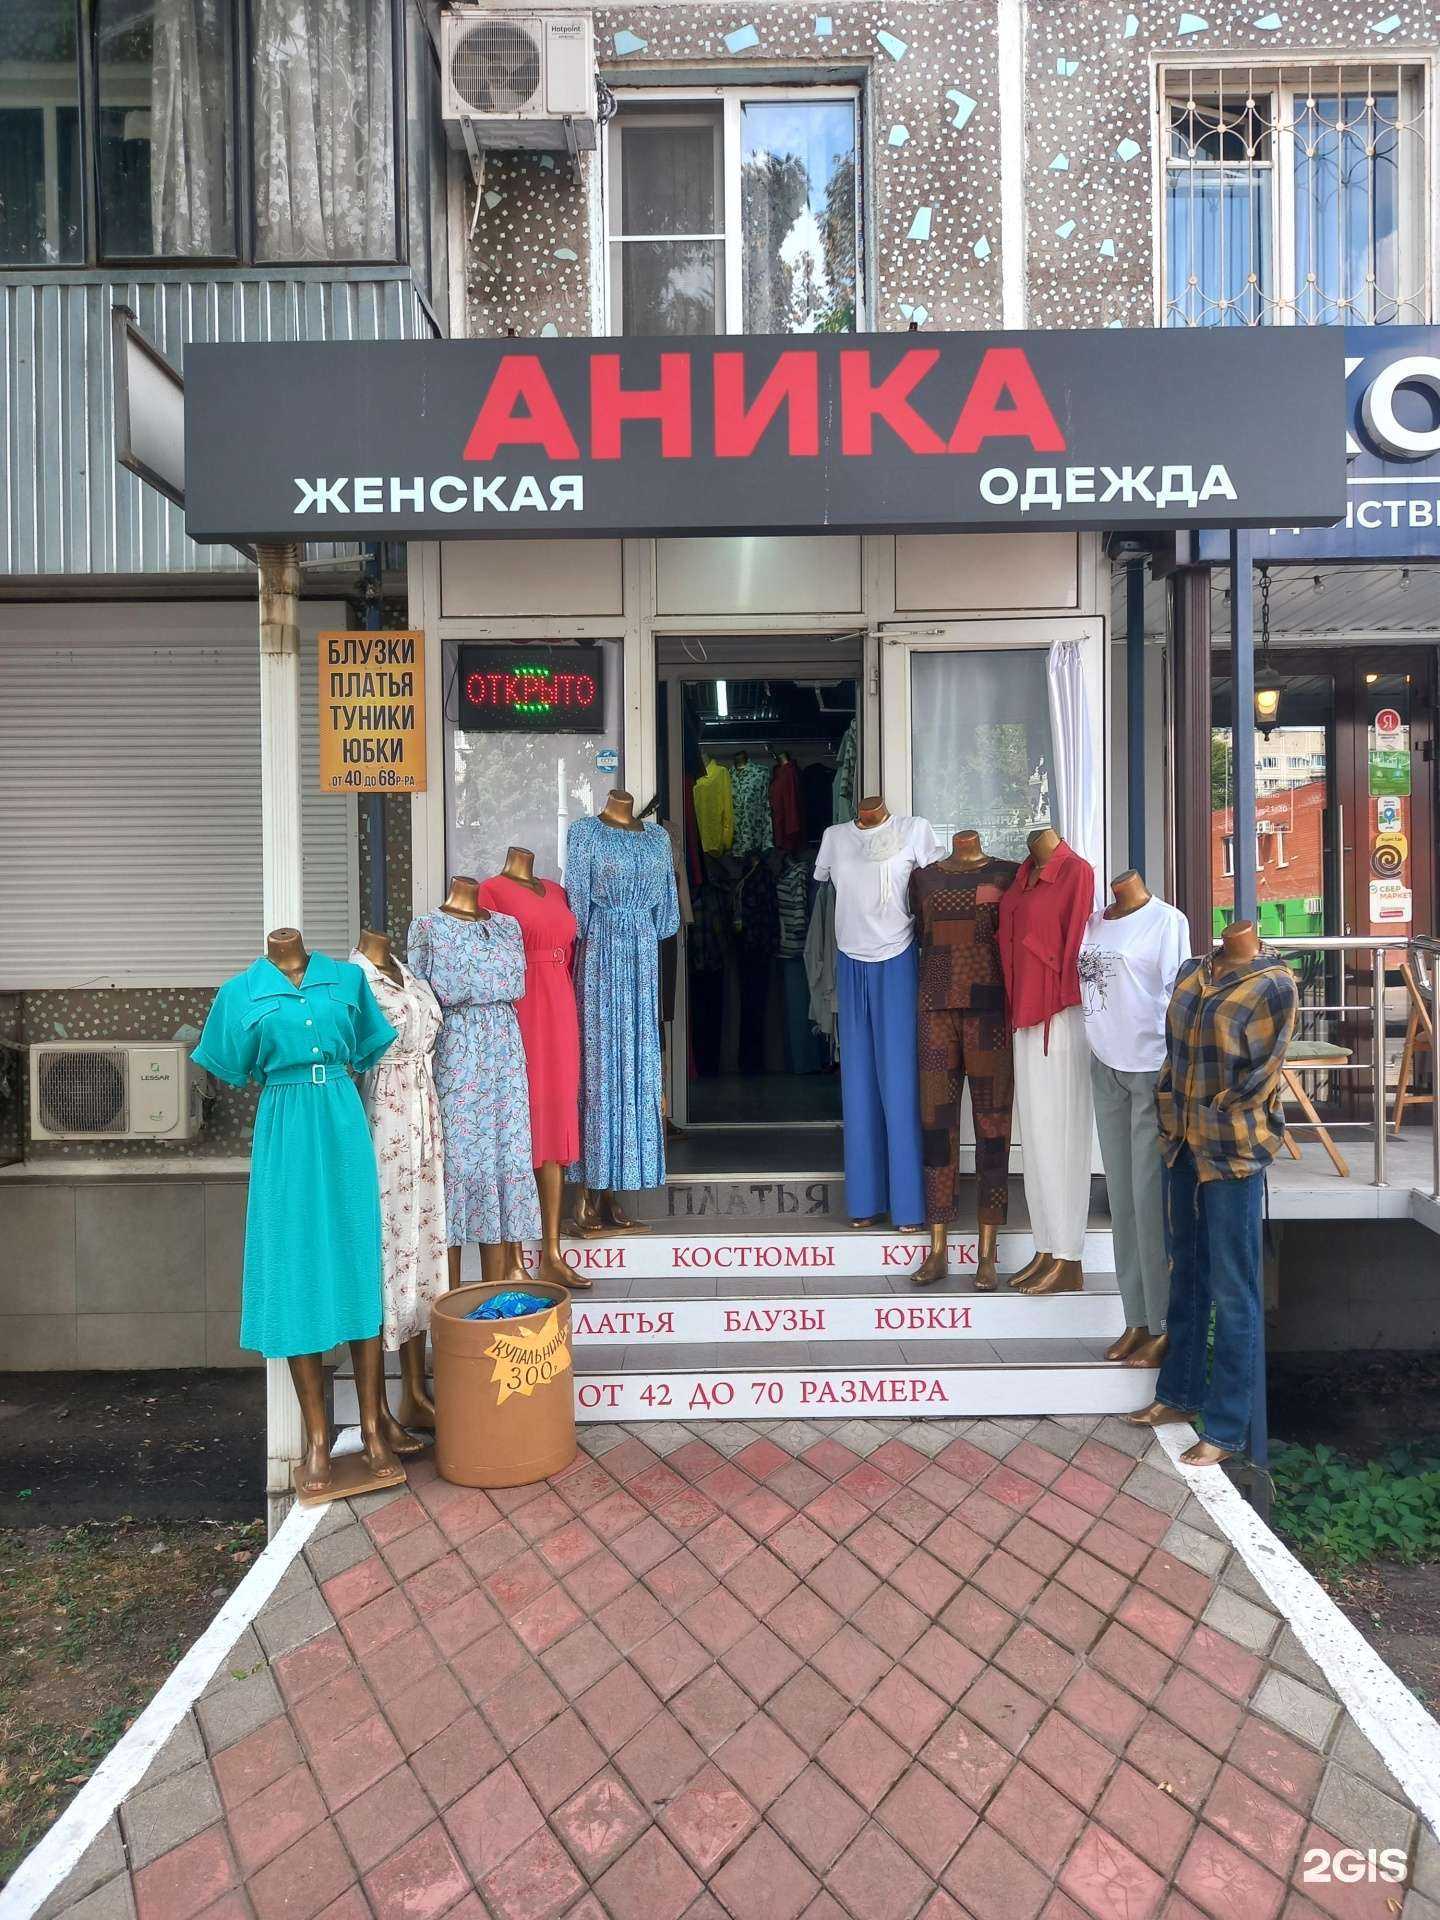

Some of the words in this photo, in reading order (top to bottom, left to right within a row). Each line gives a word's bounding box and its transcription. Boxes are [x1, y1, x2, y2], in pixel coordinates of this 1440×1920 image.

[551, 25, 582, 33] Hotpoint
[463, 347, 1066, 461] АНИКА
[293, 475, 584, 513] ЖЕНСКАЯ
[979, 464, 1238, 513] ОДЕЖДА
[328, 638, 415, 665] БЛУЗКИ
[330, 671, 414, 697] ПЛАТЬЯ
[466, 673, 596, 705] ОТКРЫТО
[329, 704, 415, 730] ТУНИКИ
[342, 737, 403, 763] ЮБКИ
[344, 769, 362, 786] 40
[672, 1245, 835, 1267] КОСТЮМЫ
[573, 1311, 675, 1335] ЛАТЬЯ
[724, 1308, 826, 1332] БЛУЗЫ
[874, 1307, 972, 1330] ЮБКИ
[578, 1383, 625, 1408] ОТ
[639, 1384, 672, 1406] 42
[688, 1383, 735, 1410] ДО
[750, 1383, 784, 1405] 70
[799, 1378, 949, 1404] РАЗМЕРА
